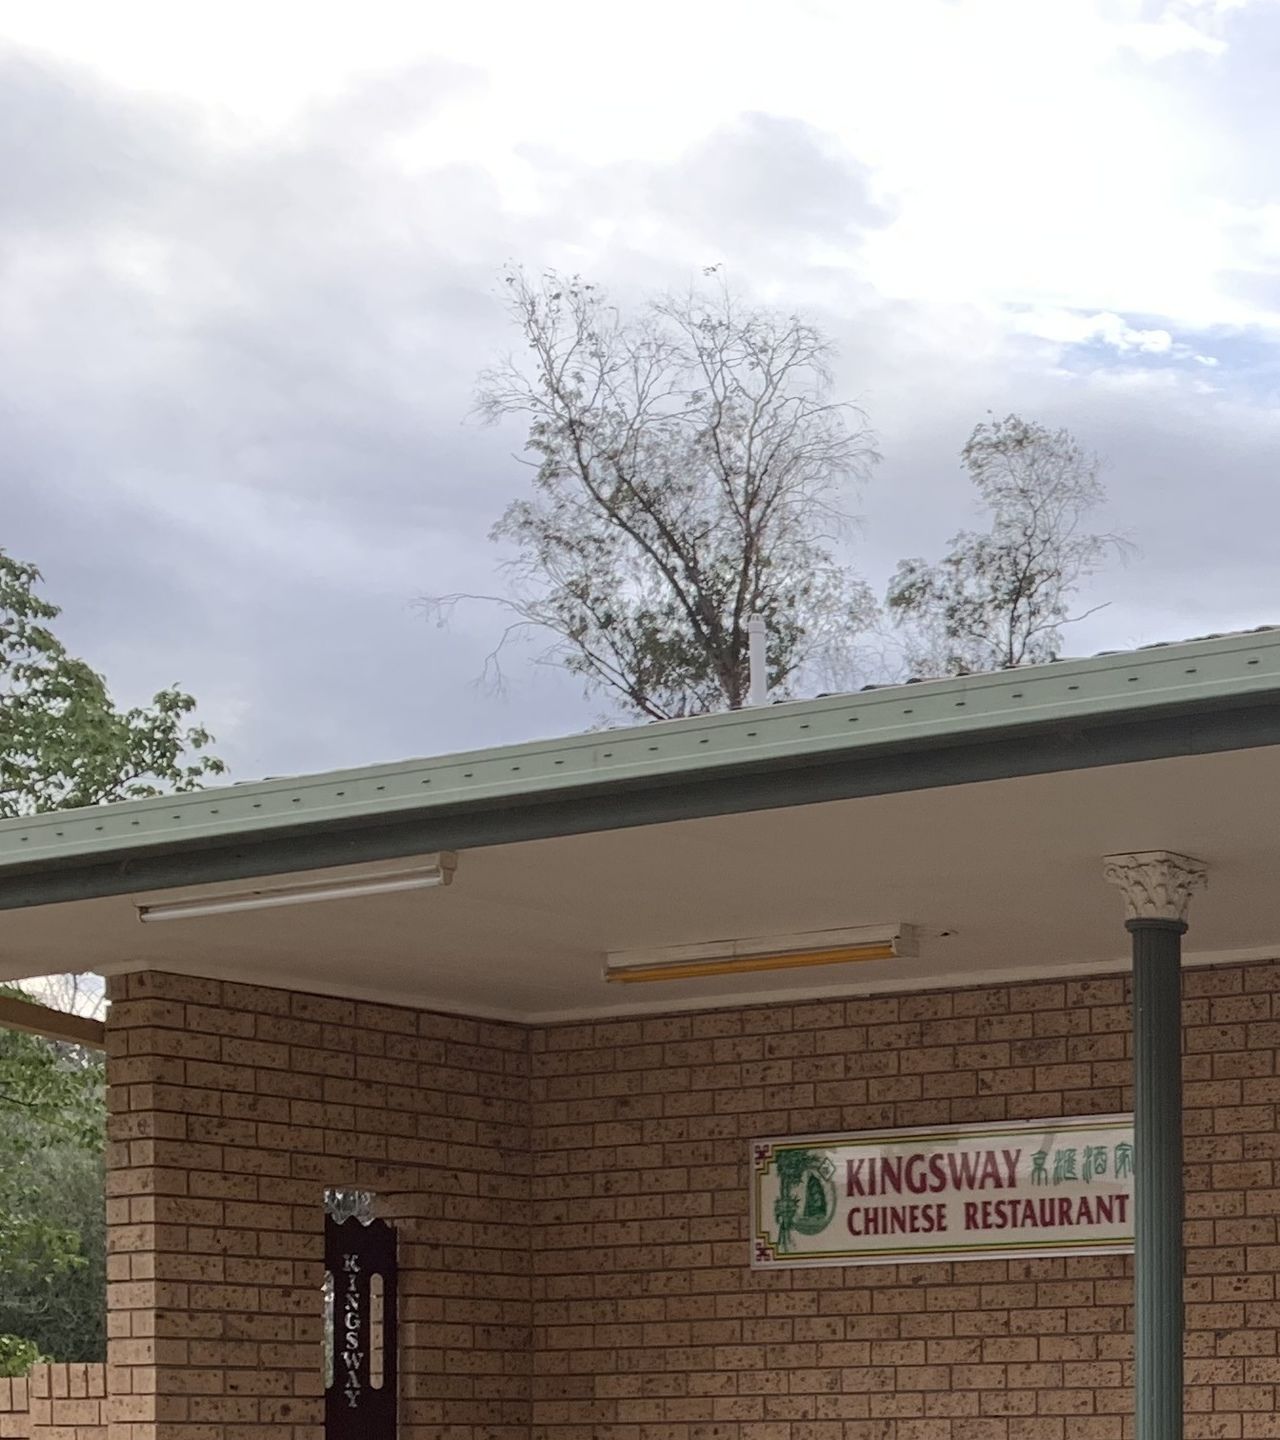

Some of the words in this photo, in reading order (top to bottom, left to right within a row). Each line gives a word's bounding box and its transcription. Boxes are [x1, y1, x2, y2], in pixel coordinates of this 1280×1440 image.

[846, 1149, 1022, 1197] KINGSWAY
[847, 1203, 947, 1236] CHINESE
[965, 1194, 1129, 1231] RESTAURANT
[341, 1254, 363, 1409] KINGSWAY
